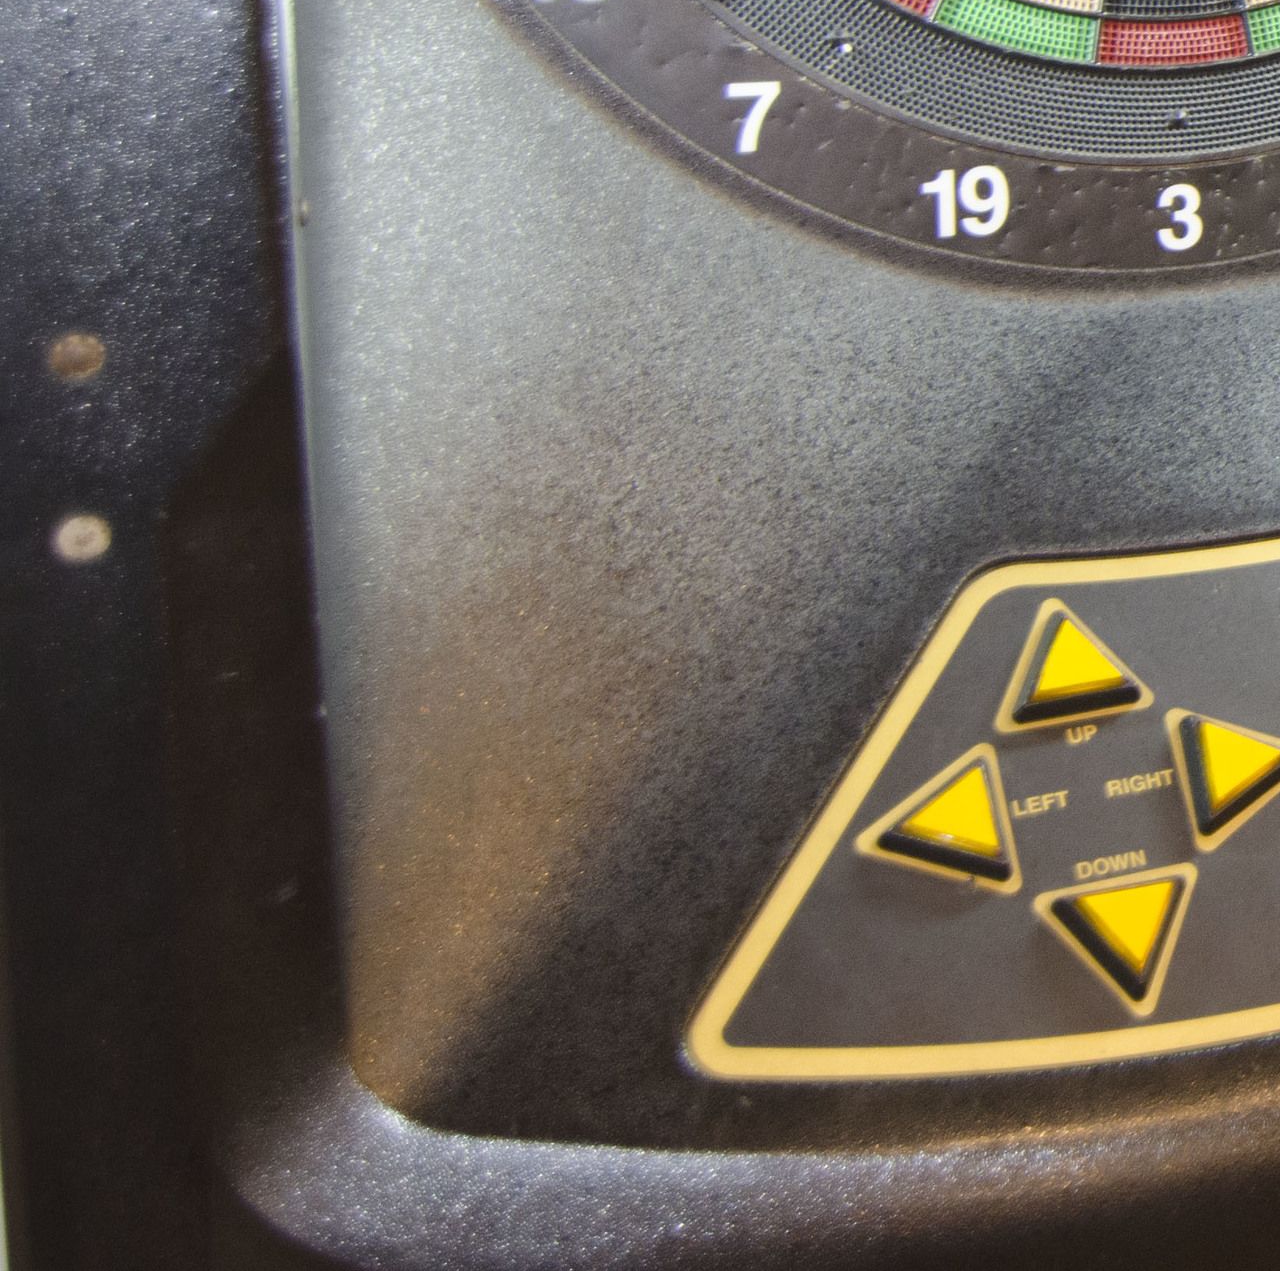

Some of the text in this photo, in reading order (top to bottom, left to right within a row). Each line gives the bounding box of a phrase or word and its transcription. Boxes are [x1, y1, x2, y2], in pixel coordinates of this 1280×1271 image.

[724, 80, 782, 155] 7
[920, 164, 1010, 239] 19
[1157, 183, 1204, 252] 3
[1065, 724, 1098, 745] UP
[1105, 768, 1174, 799] RIGHT
[1011, 790, 1070, 817] LEFT
[1075, 849, 1148, 879] DOWN
